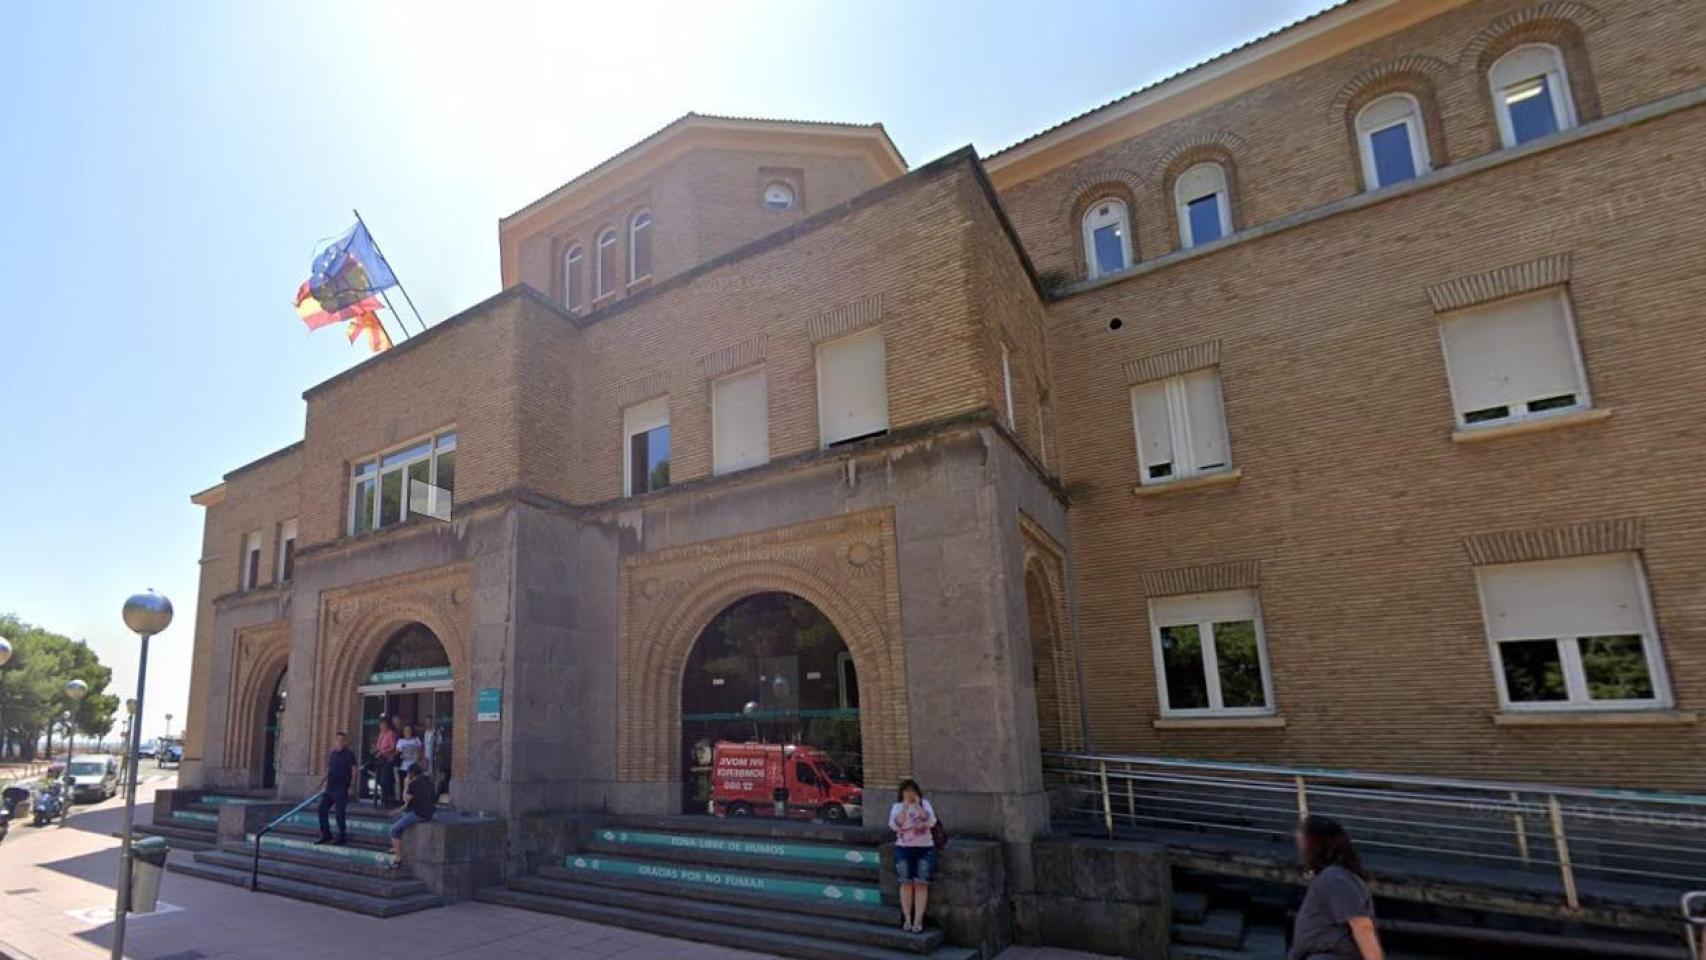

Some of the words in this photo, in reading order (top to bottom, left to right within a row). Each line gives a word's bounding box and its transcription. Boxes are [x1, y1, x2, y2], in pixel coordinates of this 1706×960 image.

[700, 839, 724, 849] LIBRE
[727, 841, 741, 852] DE
[745, 842, 785, 855] HUMOS
[638, 865, 678, 878] GRACIAS
[680, 869, 701, 880] POR
[705, 872, 721, 884] NO
[725, 874, 767, 889] FUMAR
